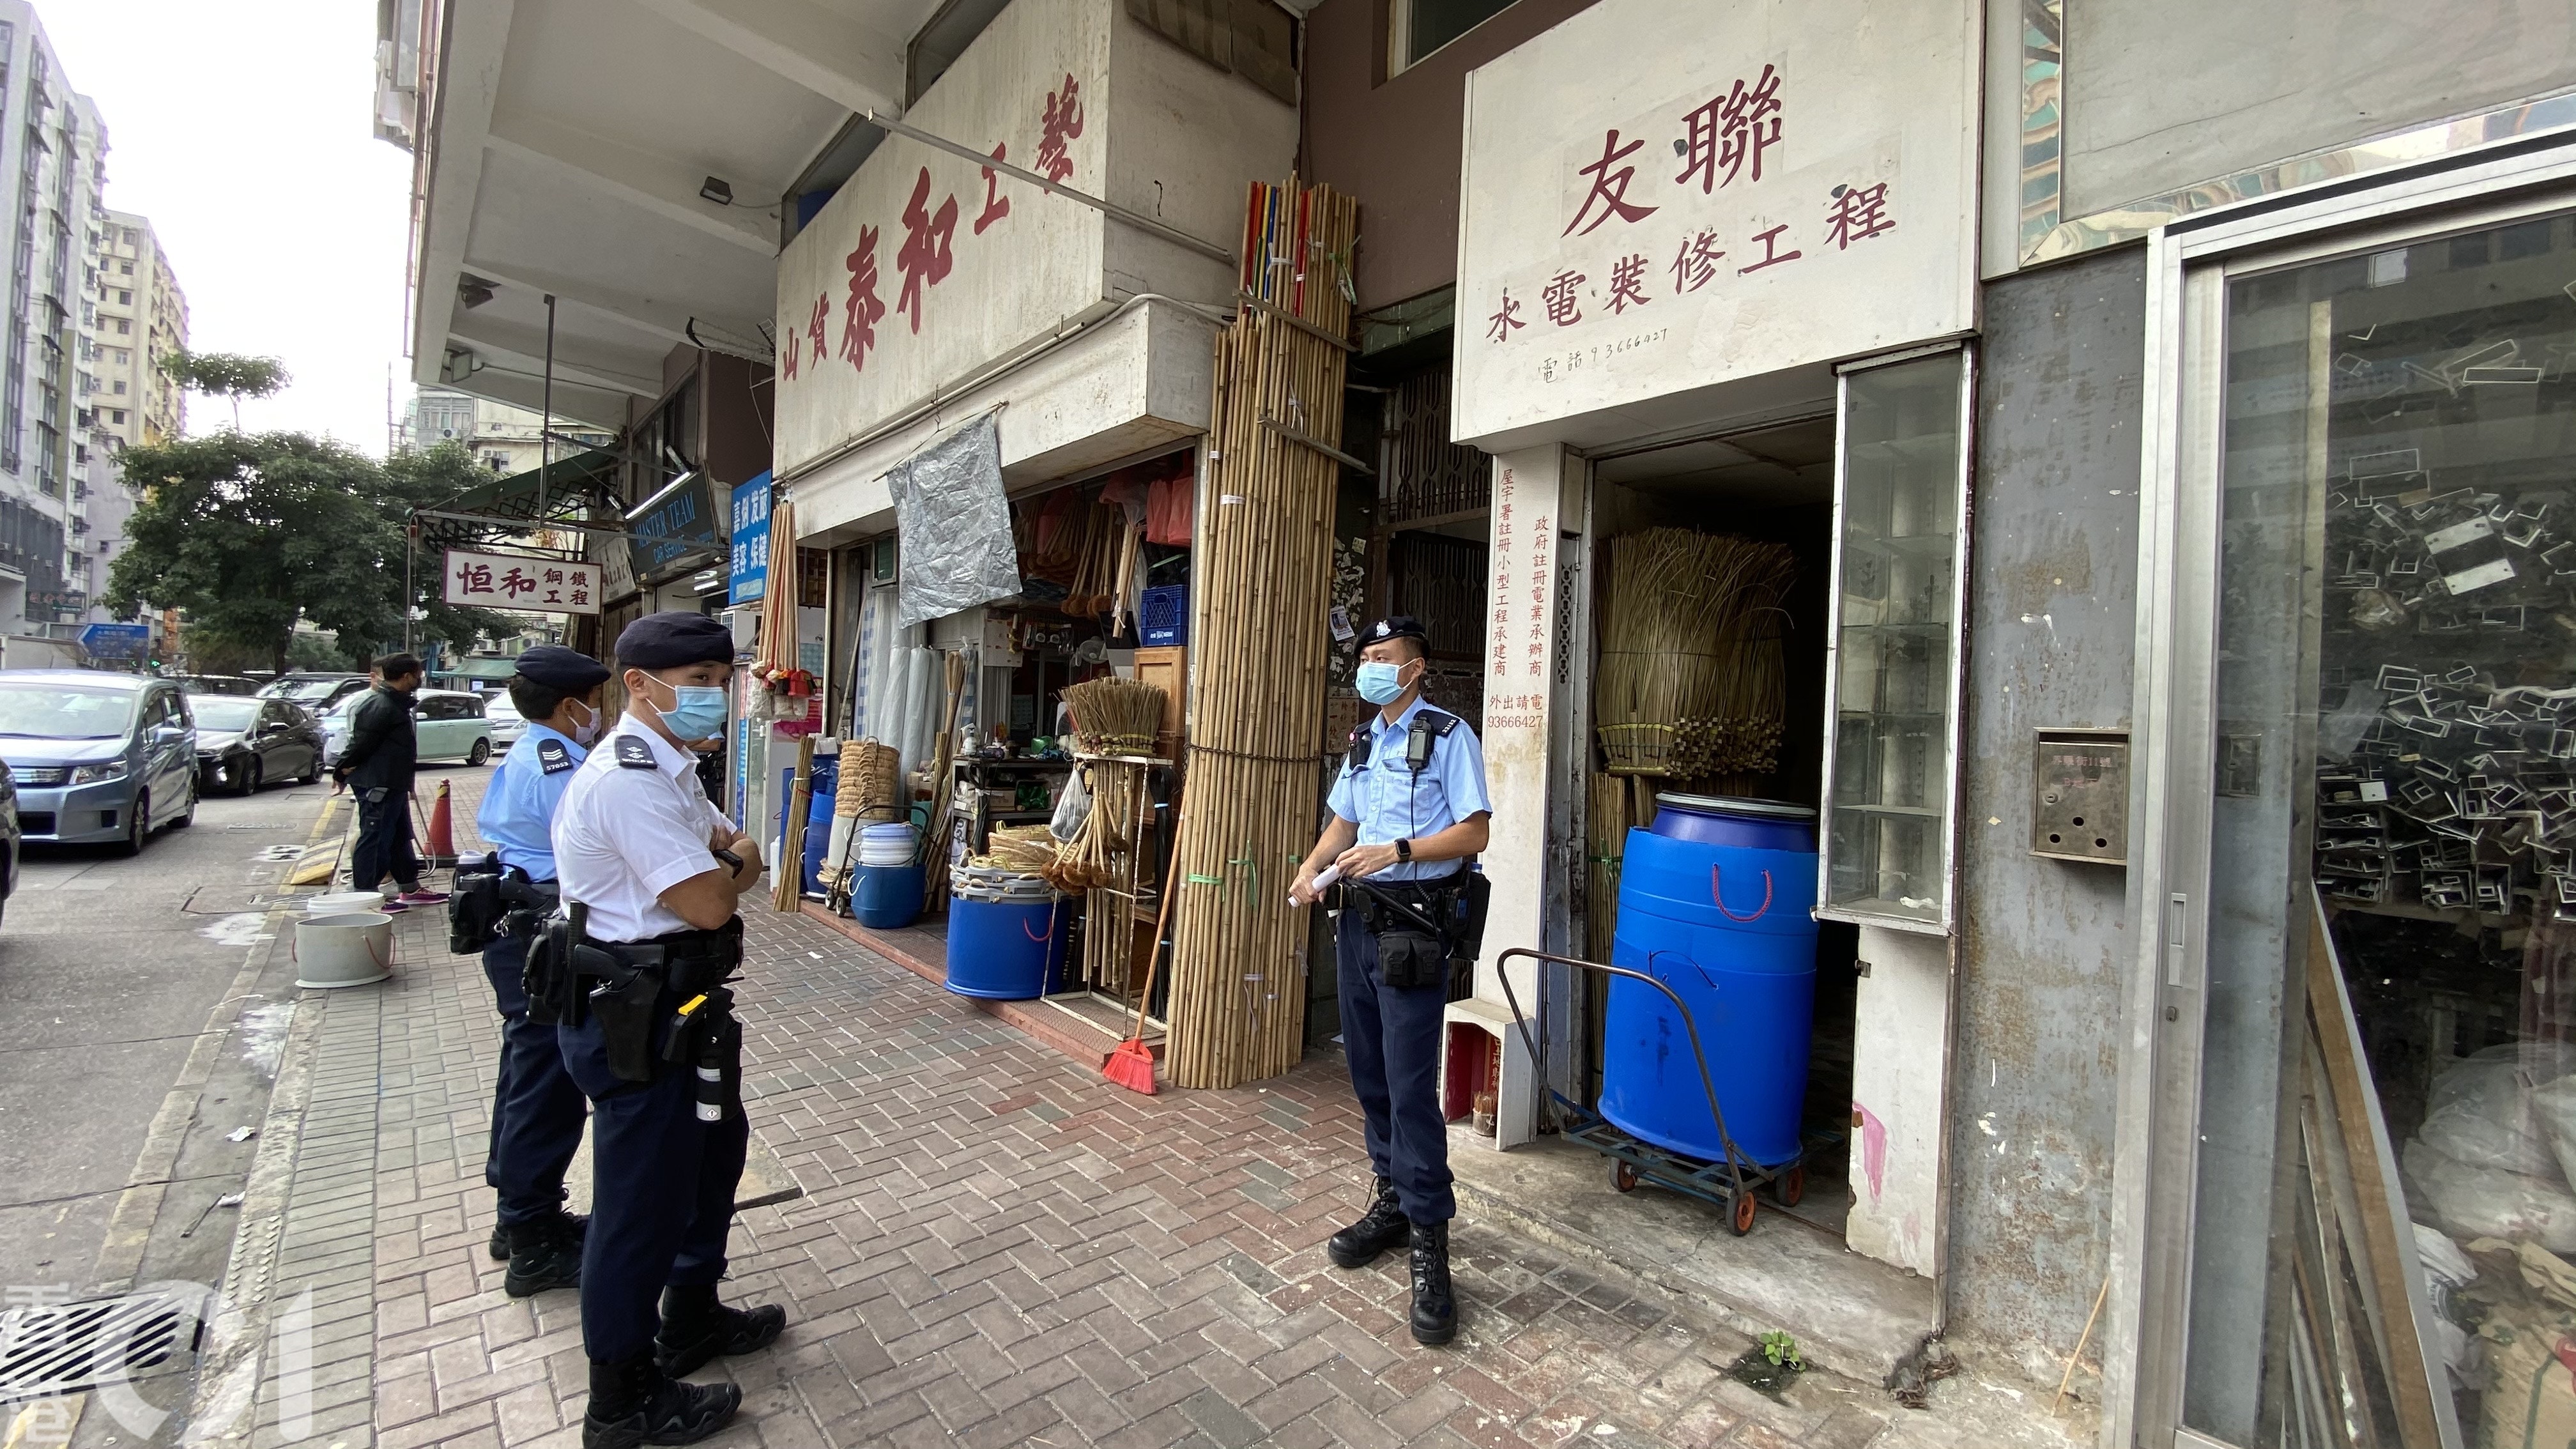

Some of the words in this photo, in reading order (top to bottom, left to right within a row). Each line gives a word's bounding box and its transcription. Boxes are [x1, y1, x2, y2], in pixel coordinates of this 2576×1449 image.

[1561, 64, 1783, 238] 友聯
[1486, 182, 1896, 342] 水電裝修工程
[1538, 351, 1582, 383] 電話
[636, 510, 668, 549] MASTER
[667, 491, 695, 531] TEAM
[457, 562, 537, 599] 恒和
[543, 568, 589, 588] 鋼鐵
[1493, 468, 1514, 677] 屋宇署註冊小型工程承建商
[542, 589, 589, 606] 工程
[1528, 516, 1549, 677] 政府註冊電業承辦商
[1489, 694, 1544, 710] 外出請電
[1488, 716, 1544, 728] 93666427
